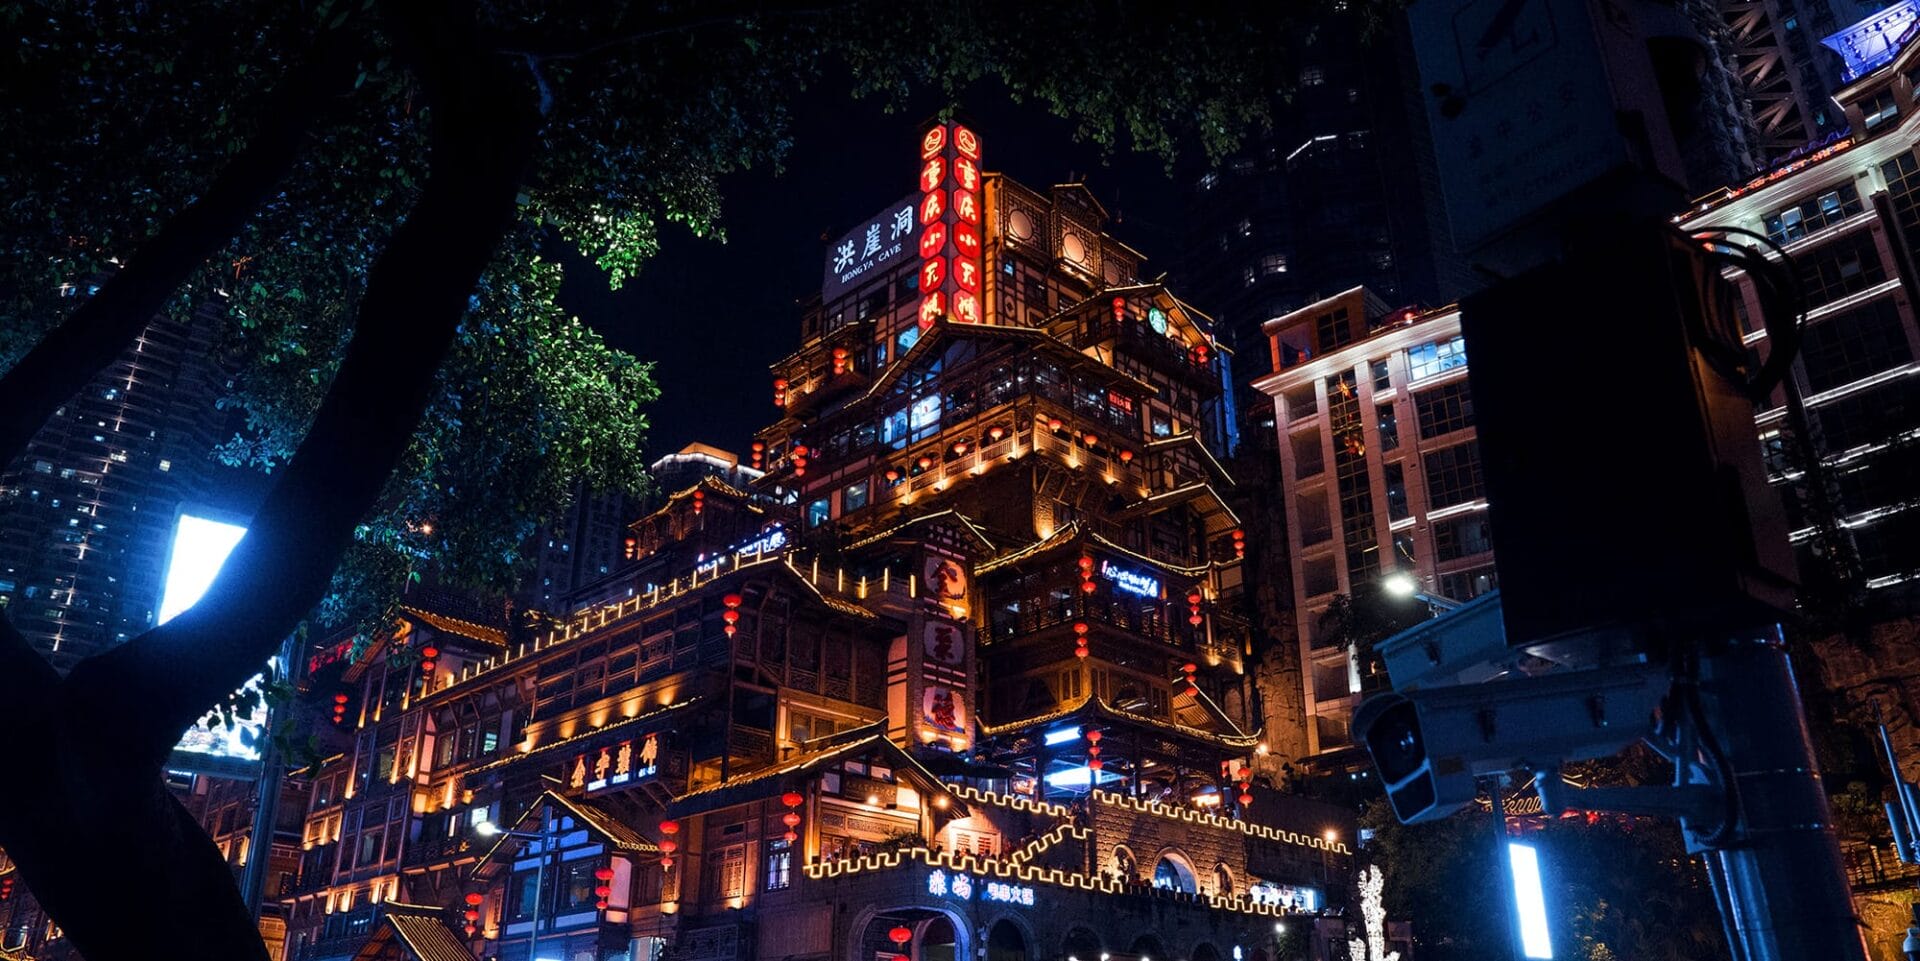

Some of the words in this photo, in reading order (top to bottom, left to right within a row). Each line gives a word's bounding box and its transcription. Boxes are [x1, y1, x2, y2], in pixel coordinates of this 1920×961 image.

[833, 205, 913, 274] 洪崖洞
[841, 260, 875, 284] HONGYA
[878, 243, 902, 262] CAVE
